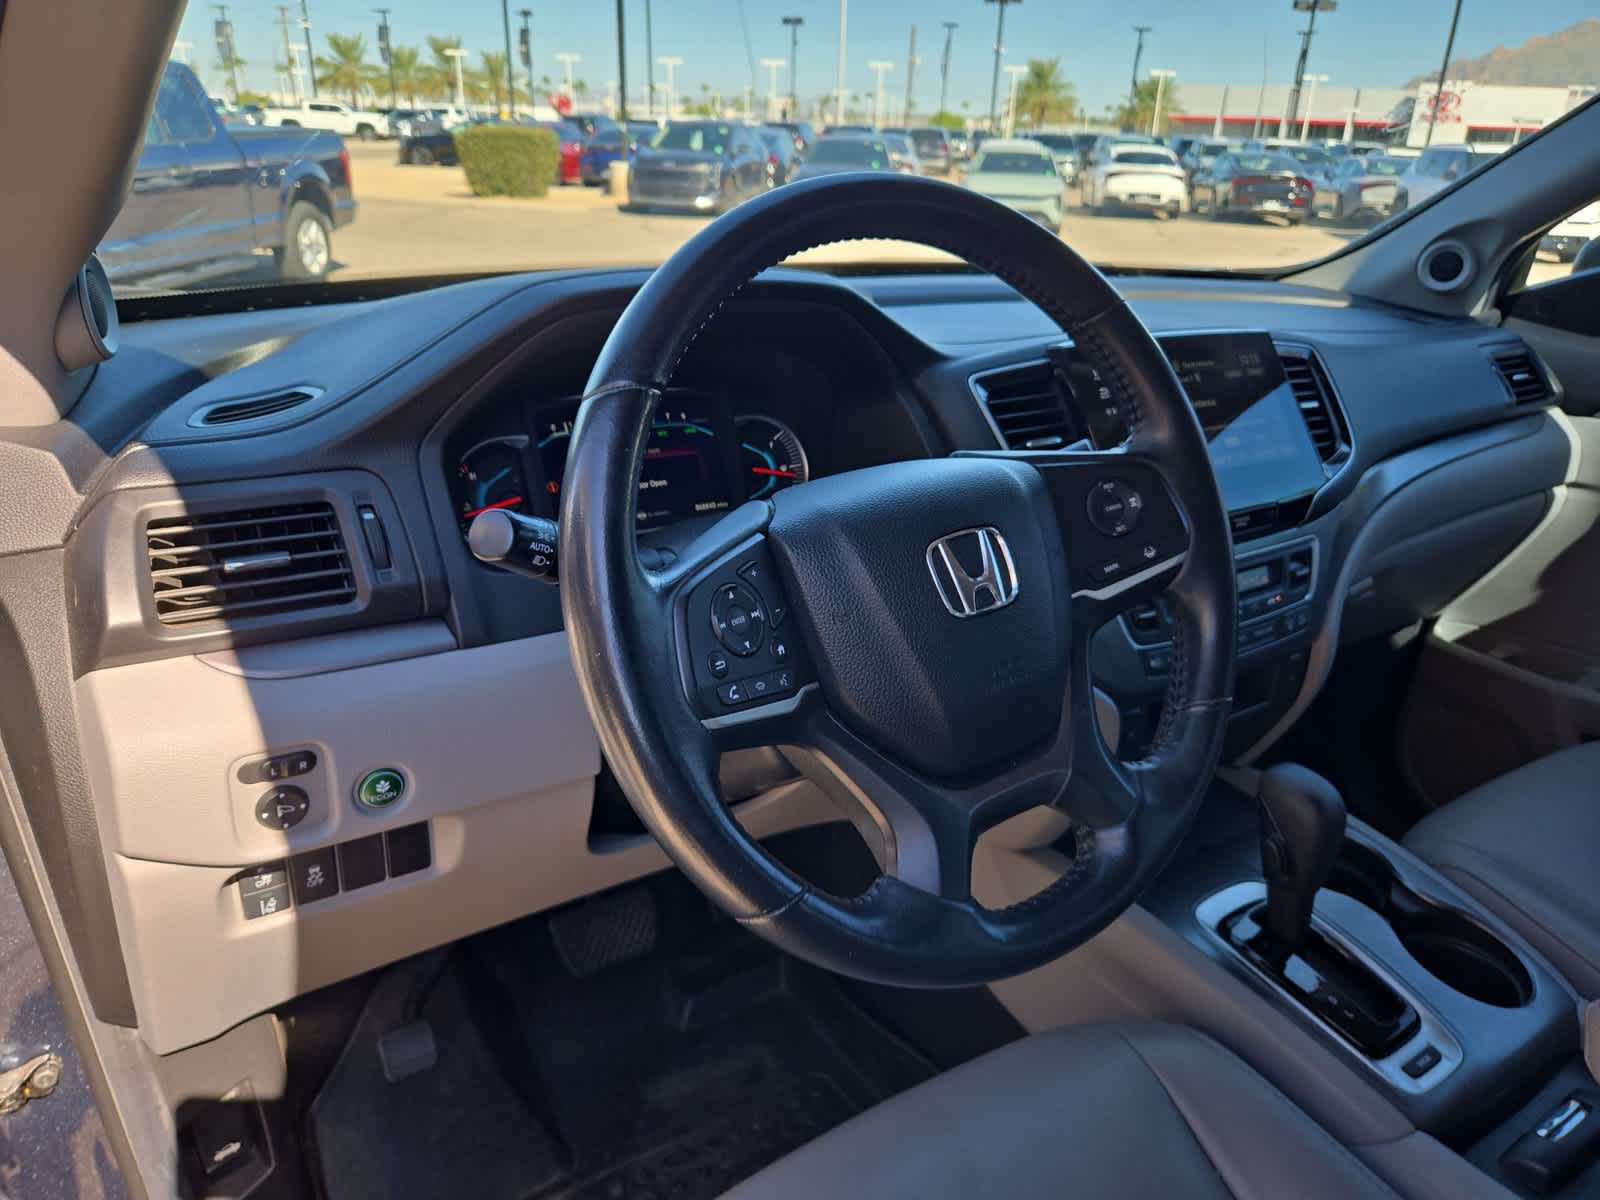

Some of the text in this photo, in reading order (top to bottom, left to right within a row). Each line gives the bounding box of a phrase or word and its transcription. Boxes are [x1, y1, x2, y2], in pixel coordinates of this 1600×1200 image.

[530, 541, 551, 553] AUTO
[299, 760, 307, 769] R
[370, 791, 397, 802] ECON
[255, 876, 273, 888] OFF
